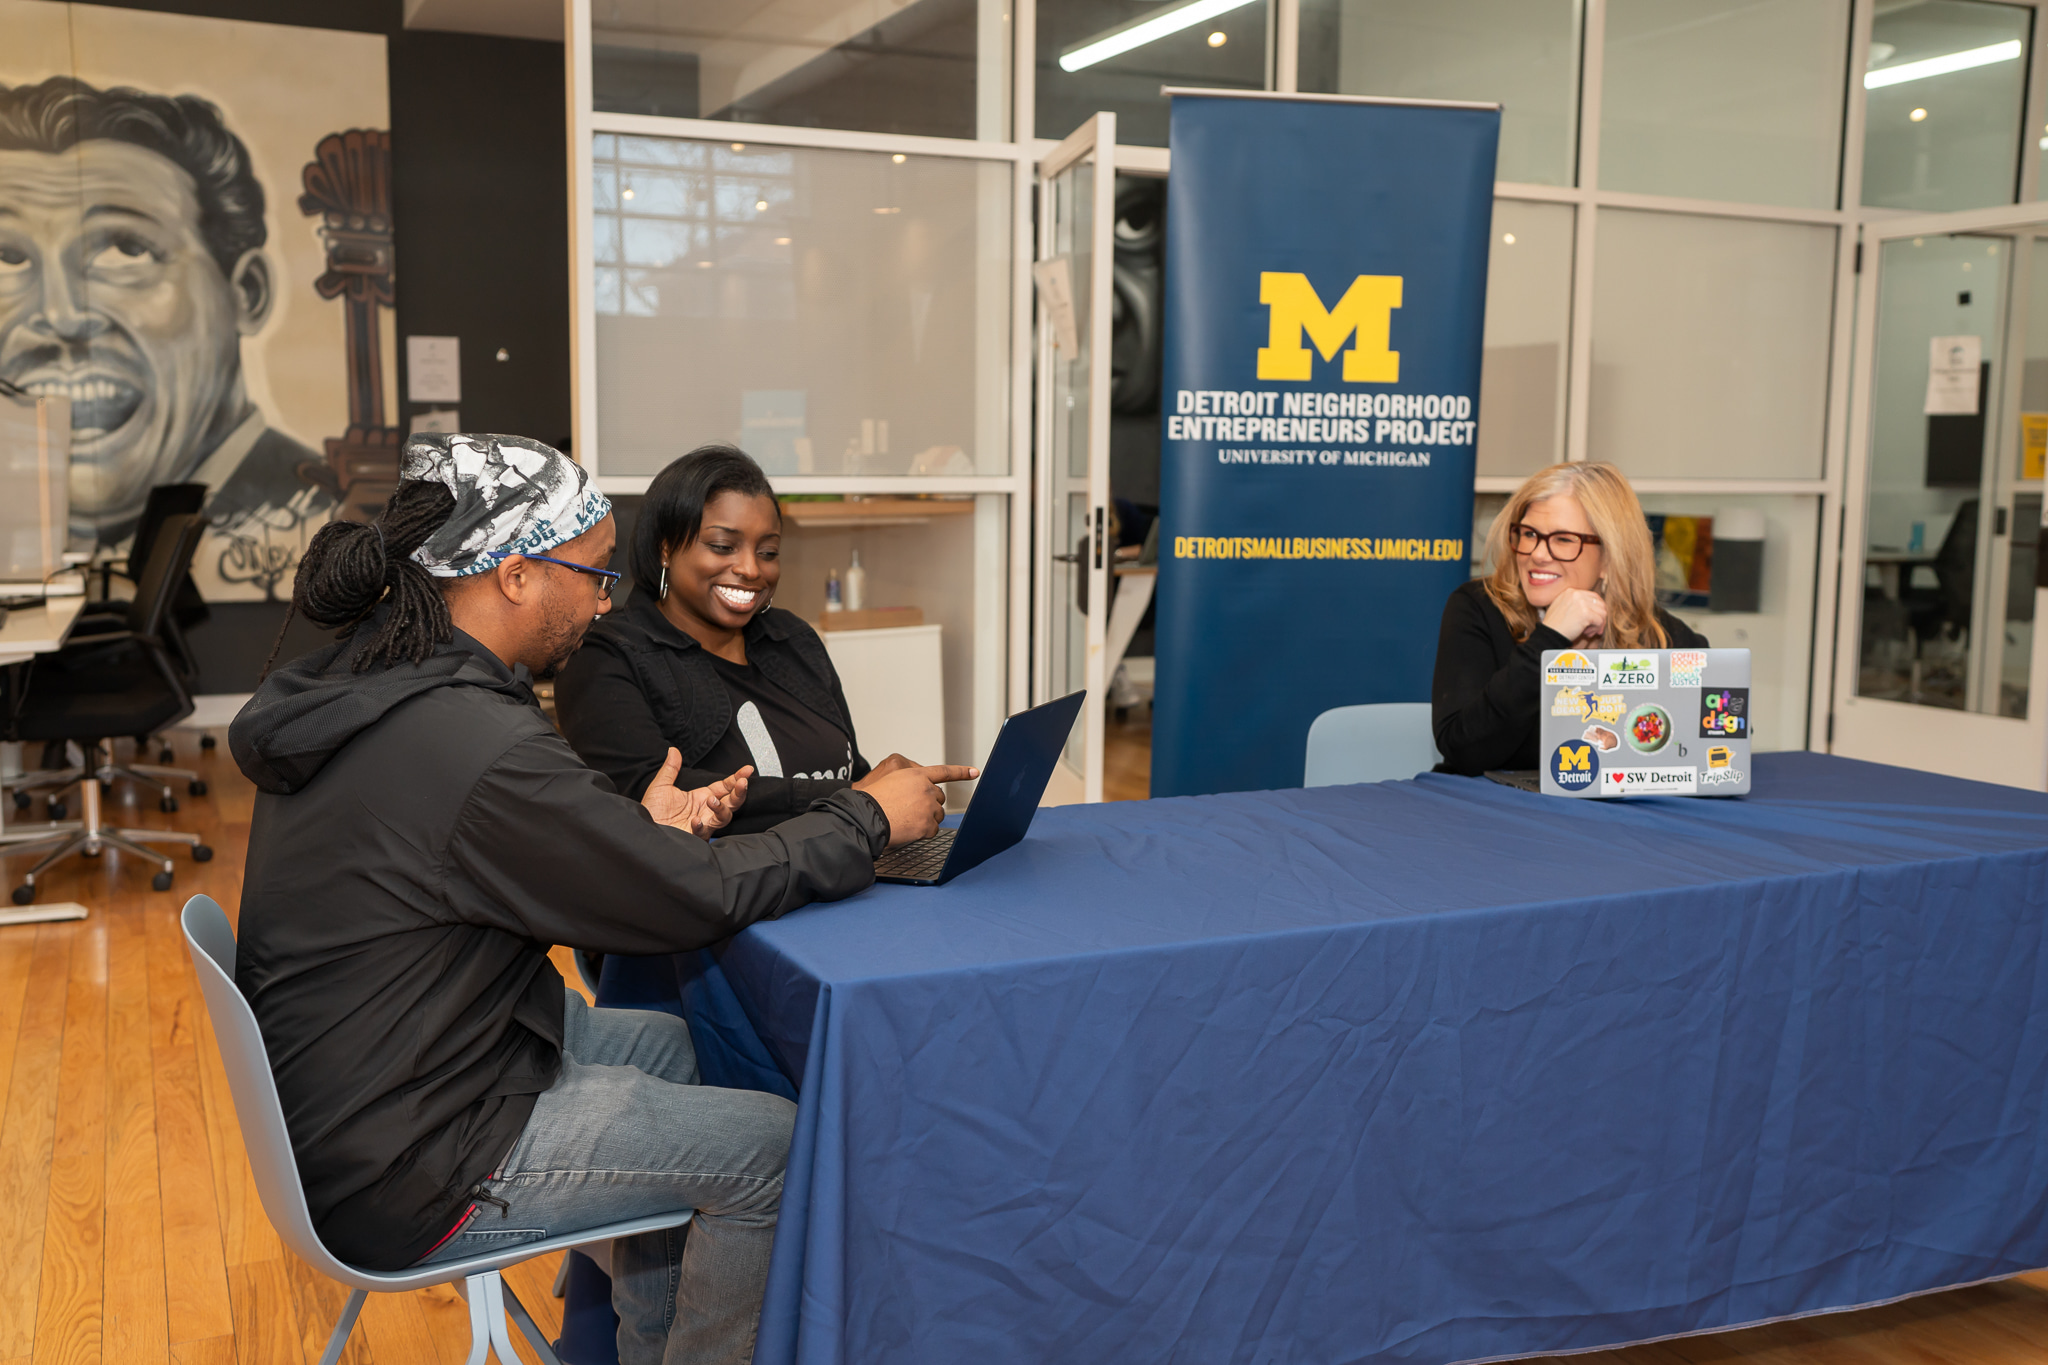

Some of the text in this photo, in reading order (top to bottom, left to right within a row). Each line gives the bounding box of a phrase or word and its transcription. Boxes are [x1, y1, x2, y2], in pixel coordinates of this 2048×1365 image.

[1257, 271, 1403, 383] M
[1177, 390, 1471, 420] DETROIT NEIGHBORHOOD
[1168, 416, 1476, 445] ENTREPRENEURS PROJECT
[1218, 449, 1431, 467] UNIVERSITY OF MICHIGAN
[1174, 536, 1463, 561] DETROITSMALLBUSINESS.UMICH.EDU
[1556, 697, 1578, 706] NEW
[1600, 696, 1622, 704] JUST
[1600, 704, 1613, 714] DO
[1559, 746, 1590, 771] M
[1558, 770, 1592, 784] Detroit
[1605, 771, 1692, 784] I SW Detroit
[1701, 770, 1743, 784] TripSlip
